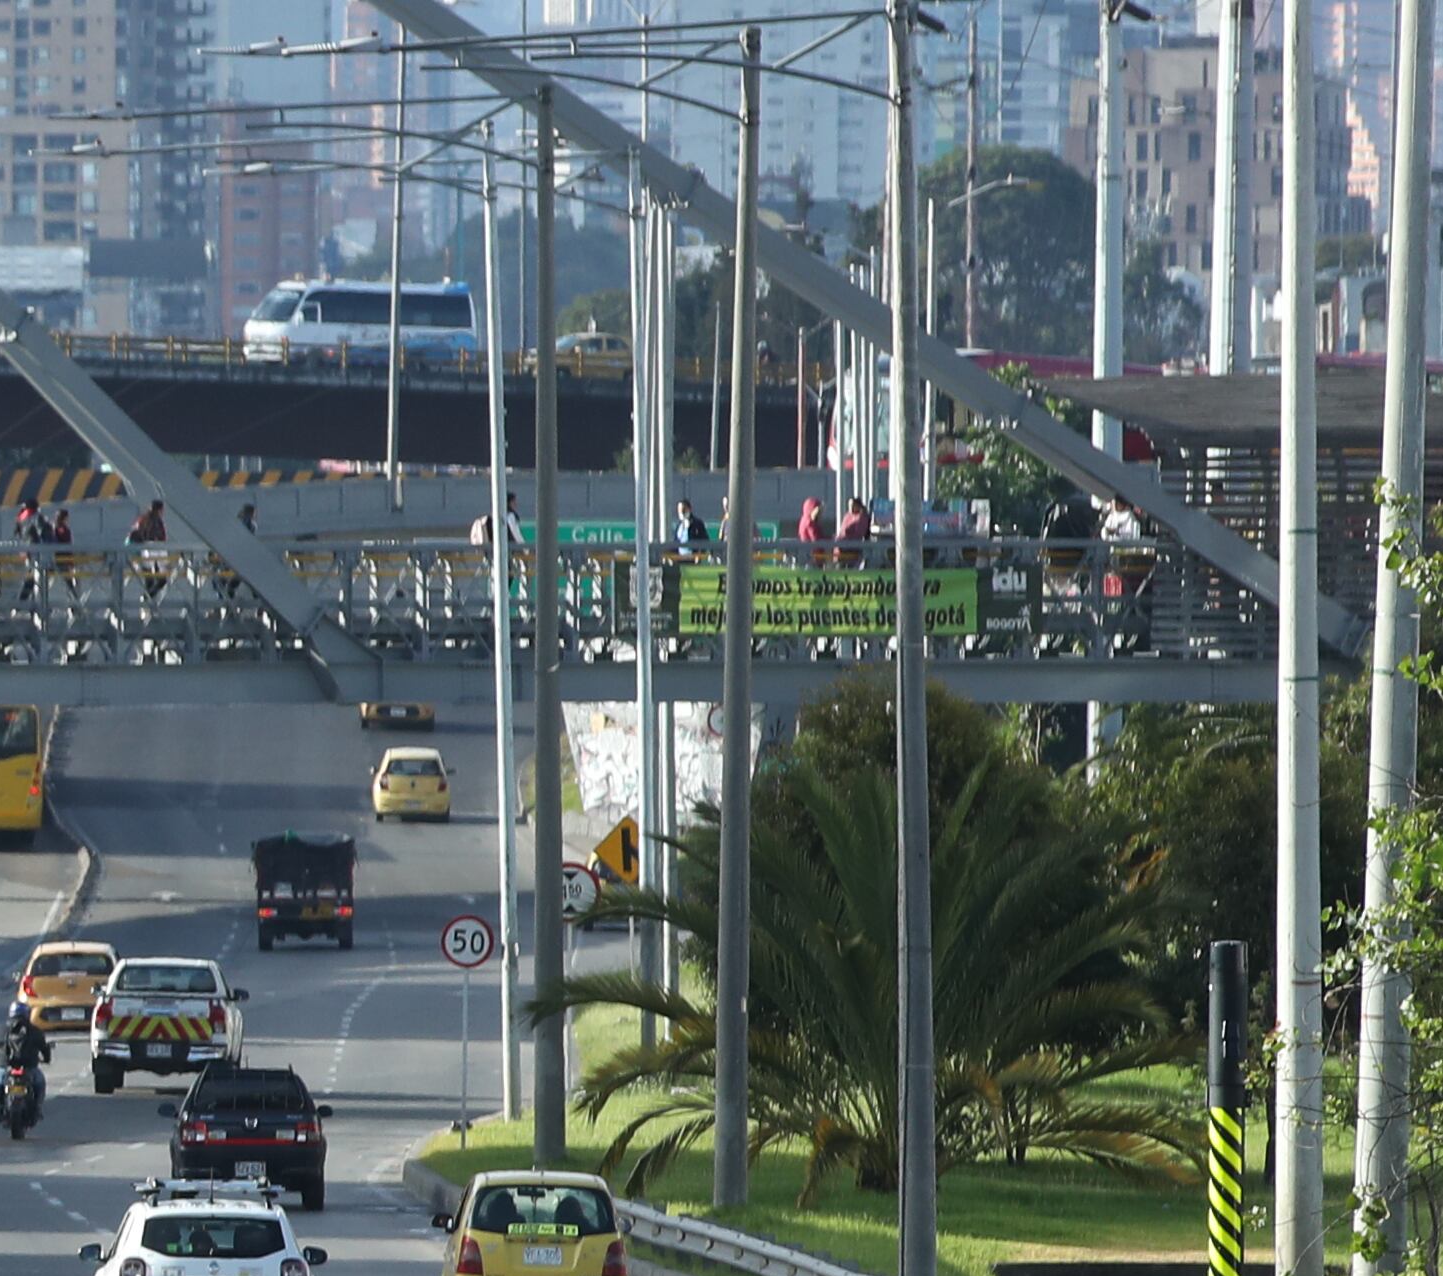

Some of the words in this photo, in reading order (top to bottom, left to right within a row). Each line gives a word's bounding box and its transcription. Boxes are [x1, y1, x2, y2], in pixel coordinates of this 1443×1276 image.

[992, 567, 1027, 592] idu
[767, 604, 793, 624] los
[798, 606, 869, 632] puentes
[453, 929, 486, 955] 50
